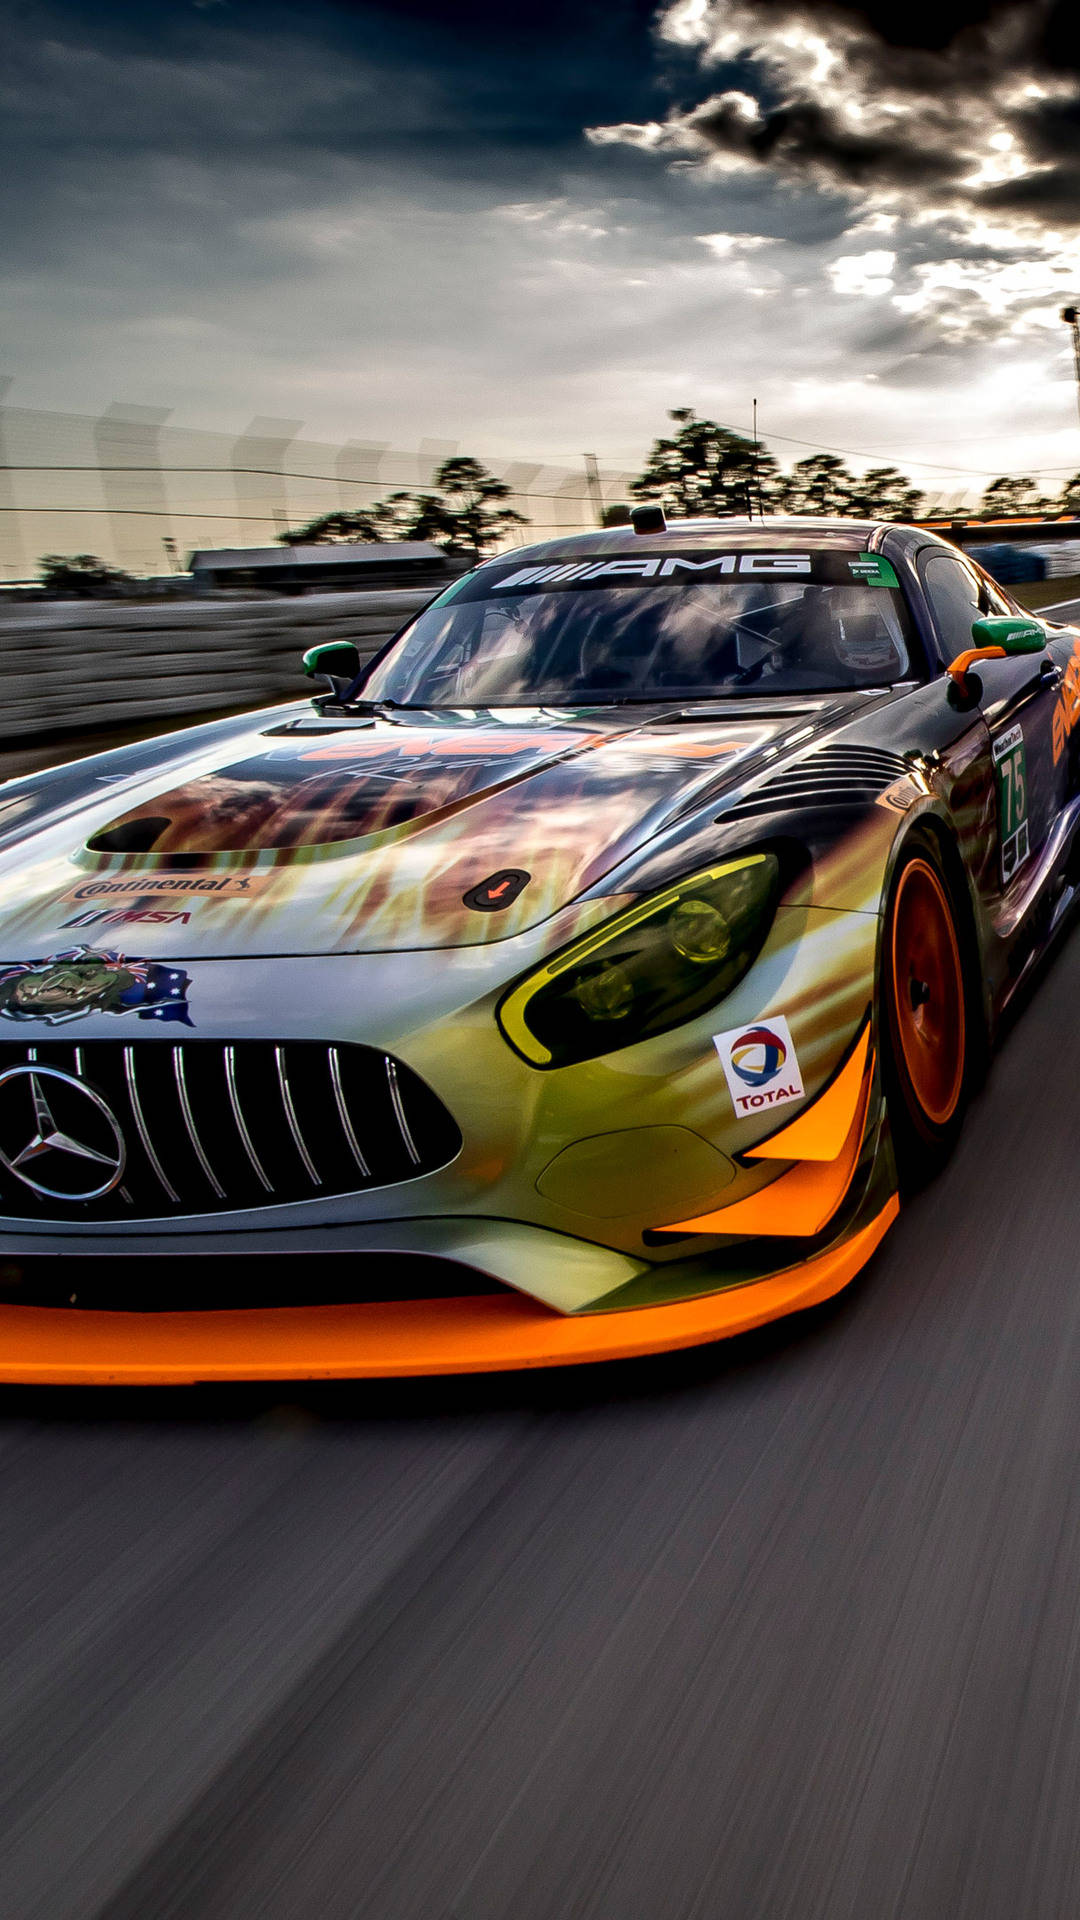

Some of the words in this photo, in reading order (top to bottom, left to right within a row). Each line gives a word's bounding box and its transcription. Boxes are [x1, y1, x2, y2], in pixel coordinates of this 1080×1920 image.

[580, 554, 811, 581] AMG
[1001, 751, 1026, 832] 75
[74, 877, 233, 900] Continental
[736, 1085, 801, 1111] TOTAL
